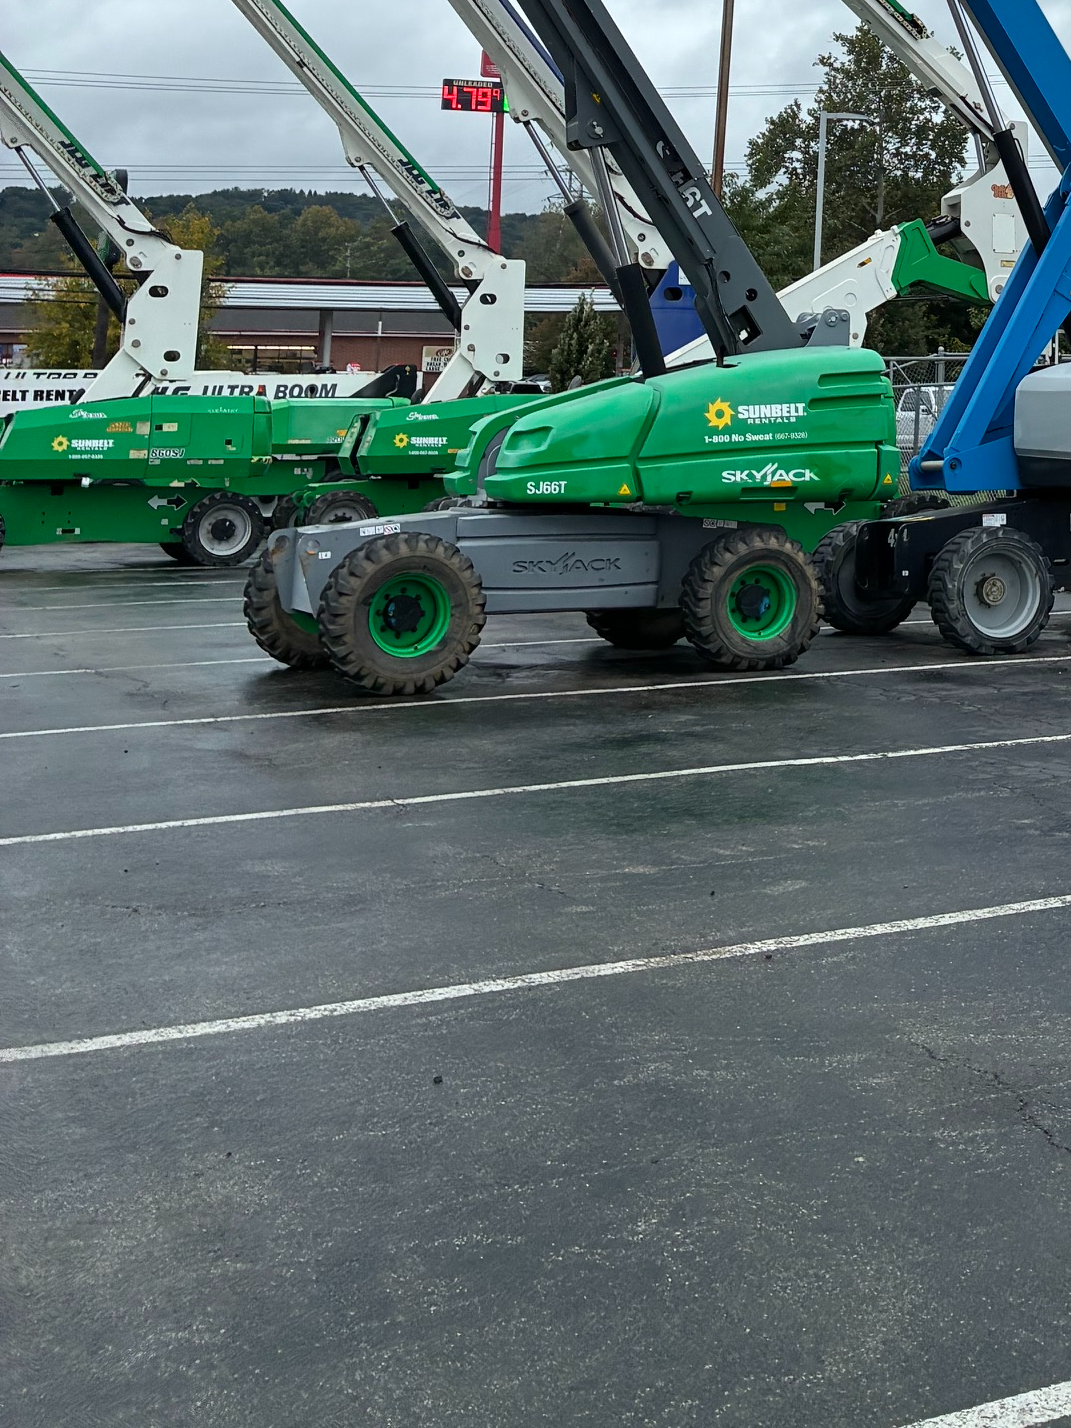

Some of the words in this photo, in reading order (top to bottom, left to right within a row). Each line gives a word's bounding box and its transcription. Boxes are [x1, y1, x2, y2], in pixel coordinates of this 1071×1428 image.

[453, 79, 493, 87] UNLEADED
[0, 389, 29, 402] ELT
[737, 403, 806, 419] SUNBELT
[747, 417, 797, 425] RENTALS
[71, 439, 115, 448] SUNBELT
[410, 437, 448, 445] SUNBELT
[704, 434, 730, 444] 1-800
[732, 433, 744, 443] No
[745, 432, 773, 441] Sweat
[721, 462, 821, 486] SKYJACK
[526, 481, 568, 495] SJ66T
[512, 551, 622, 576] SKYJACK
